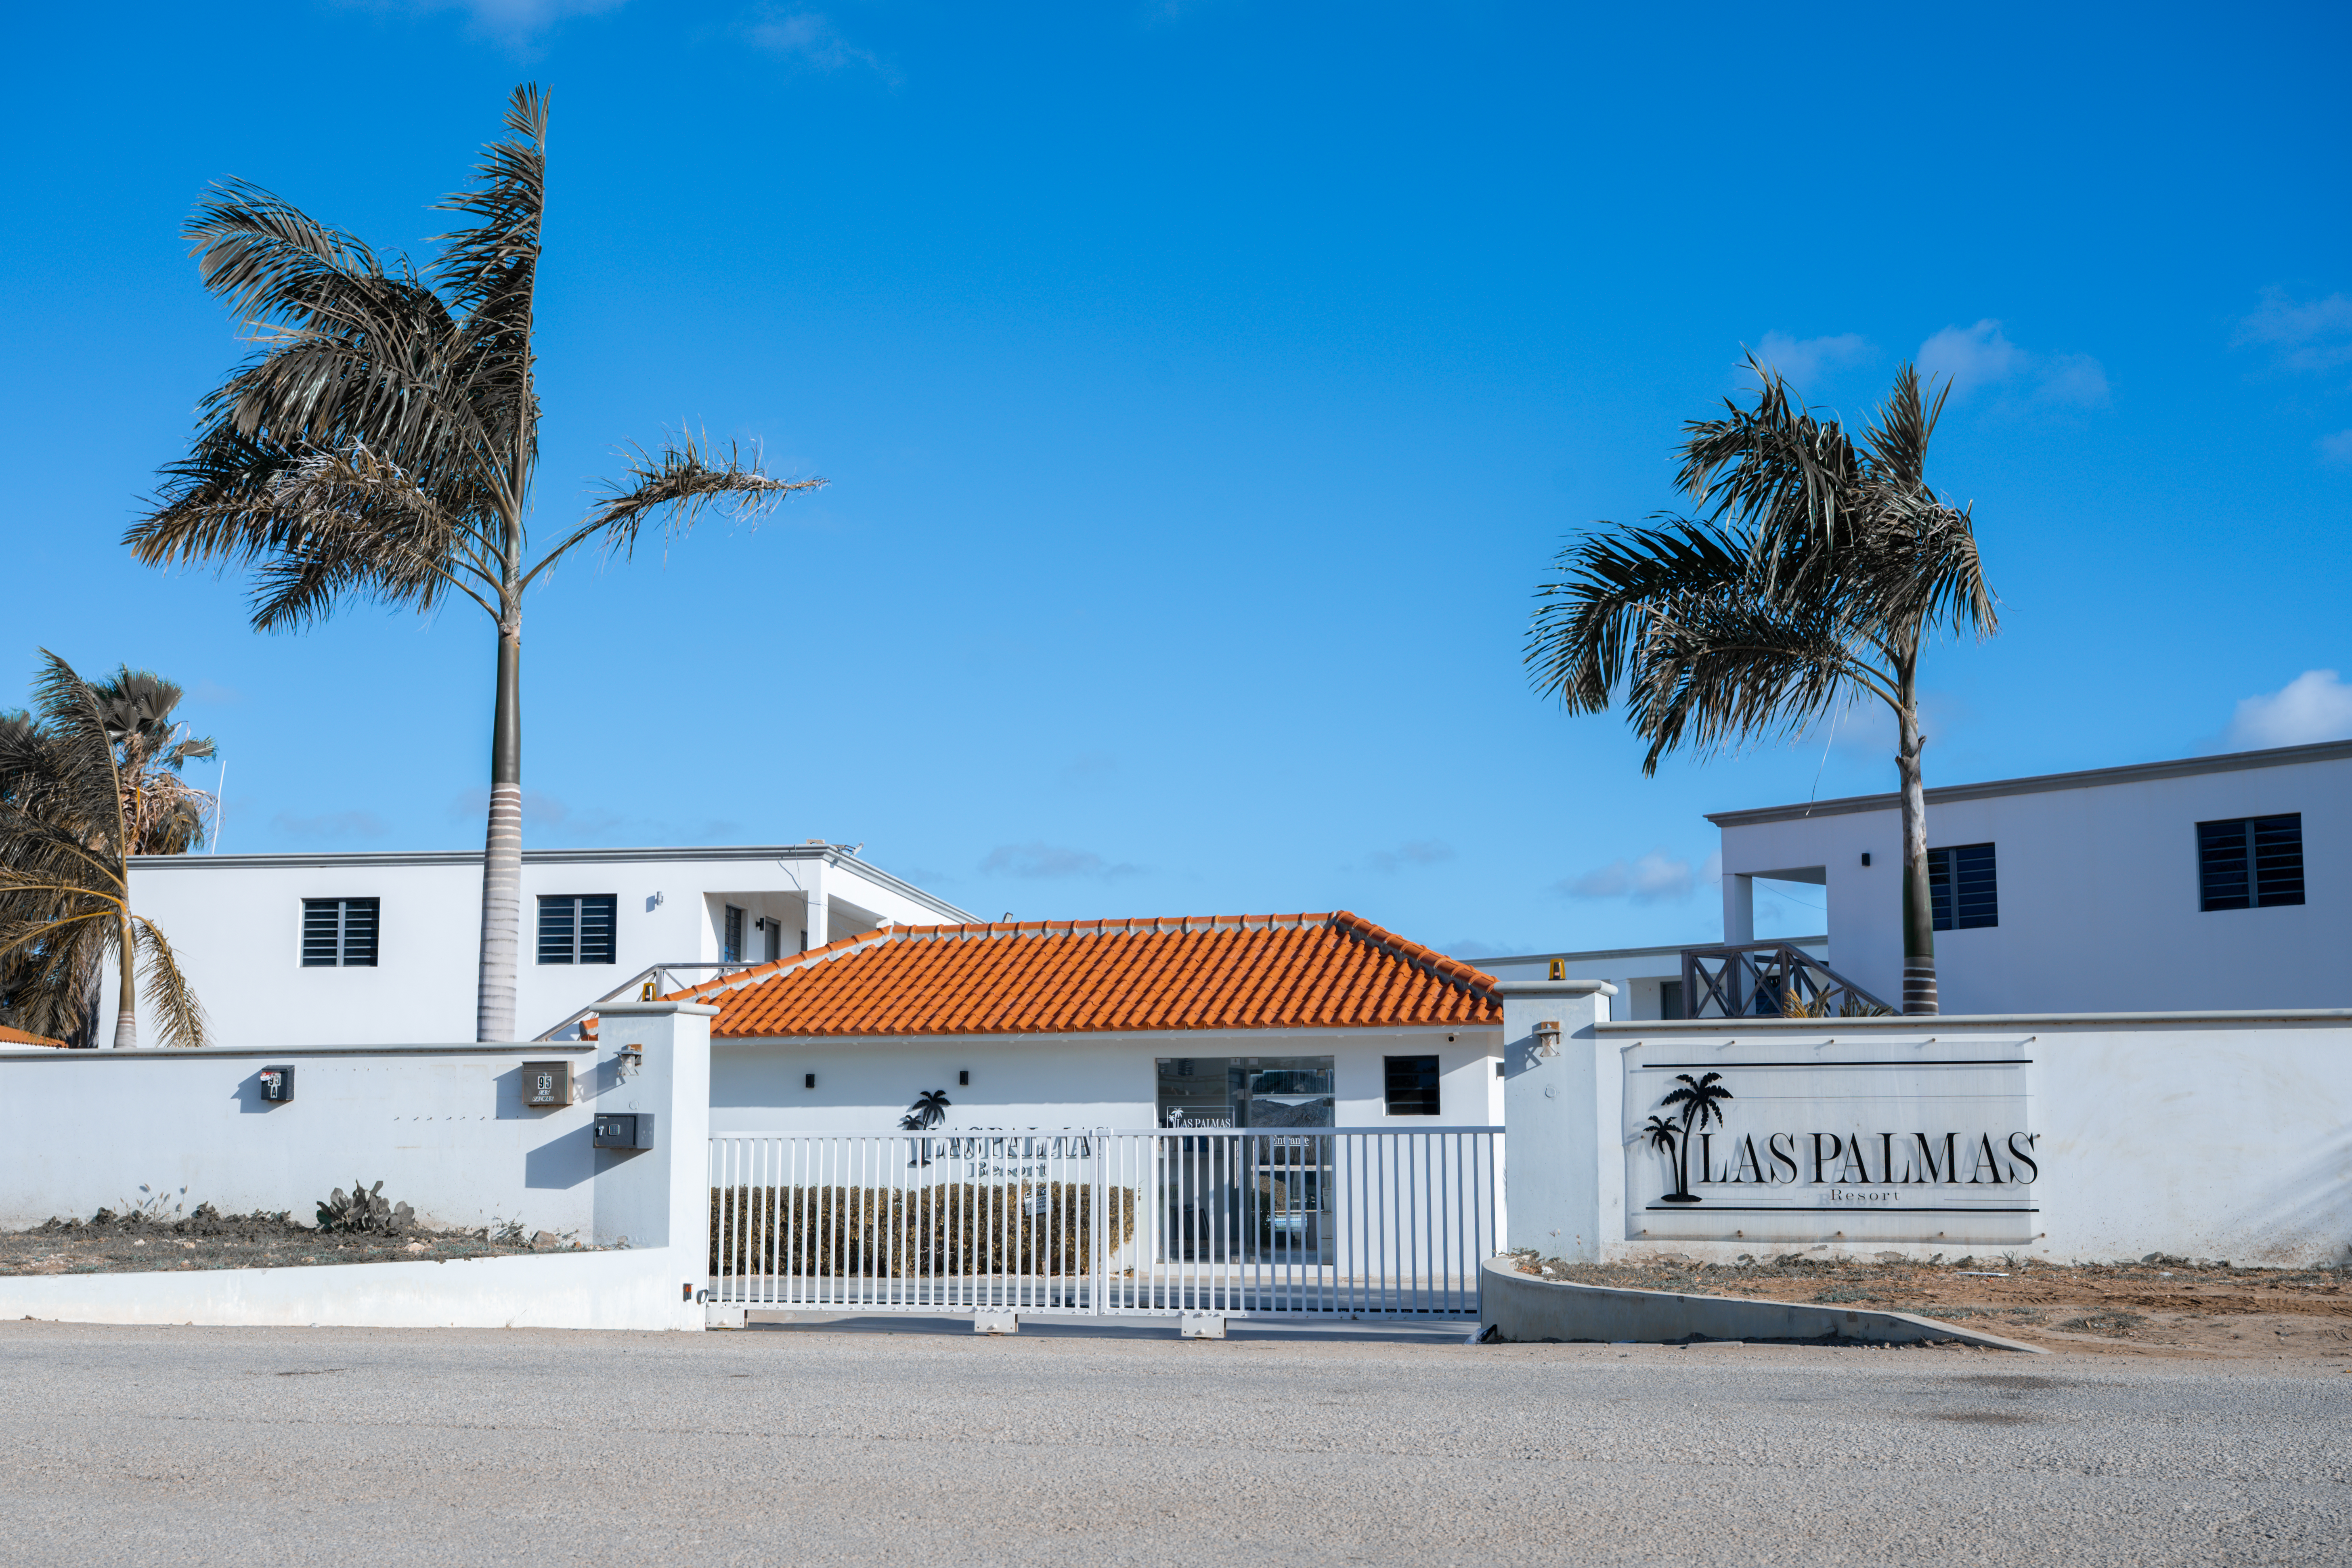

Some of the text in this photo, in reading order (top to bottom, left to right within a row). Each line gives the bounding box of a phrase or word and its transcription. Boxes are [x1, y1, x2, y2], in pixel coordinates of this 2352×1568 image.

[539, 1077, 551, 1088] 95
[271, 1086, 277, 1097] A
[1176, 1118, 1231, 1128] LAS PALMAS
[1697, 1132, 2038, 1184] LAS PALMAS
[1831, 1189, 1901, 1202] Resort
